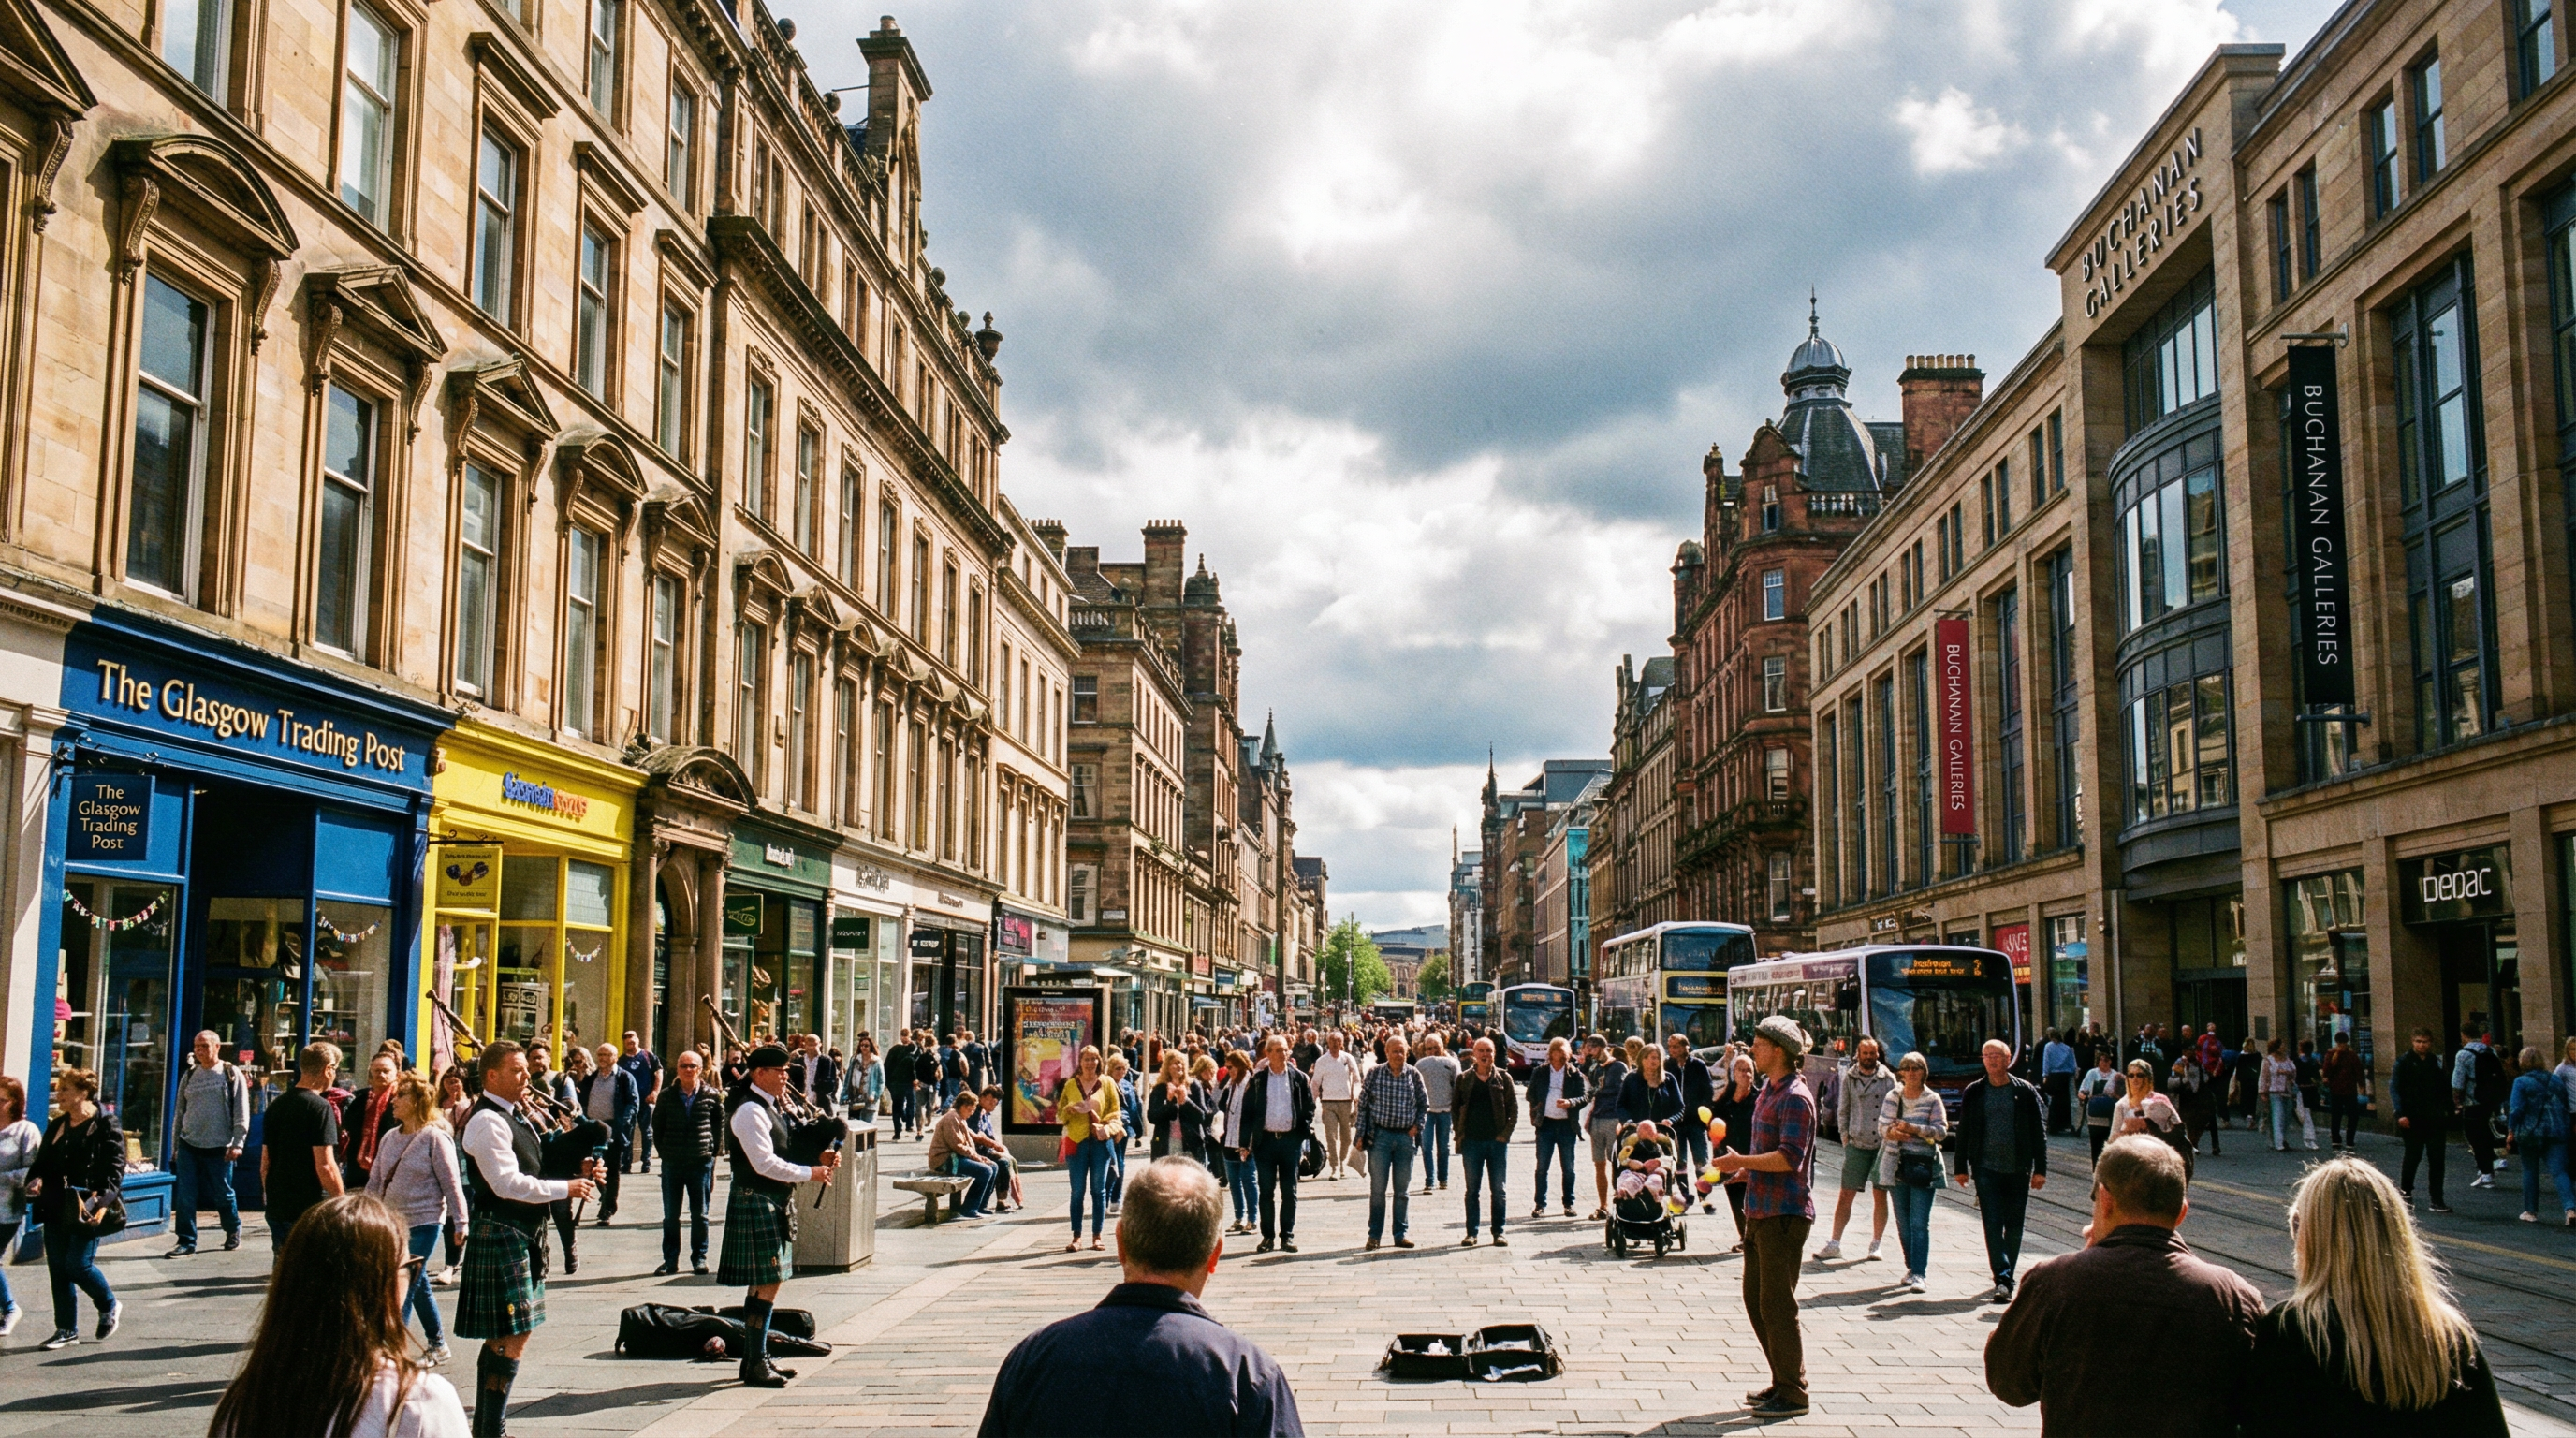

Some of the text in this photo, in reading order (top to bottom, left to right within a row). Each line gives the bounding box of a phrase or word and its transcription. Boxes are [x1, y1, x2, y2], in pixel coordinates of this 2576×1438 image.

[2082, 127, 2201, 282] BUCHANAN
[2085, 177, 2203, 318] GALLERIES
[2304, 385, 2338, 666] BUCHANAN GALLERIES
[97, 658, 406, 772] The Glasgow Trading Post
[1946, 644, 1965, 811] BUCHANAN GALLERIES
[78, 800, 141, 820] Glasgow
[80, 816, 139, 836] Trading
[92, 834, 124, 849] Post
[95, 784, 124, 800] The
